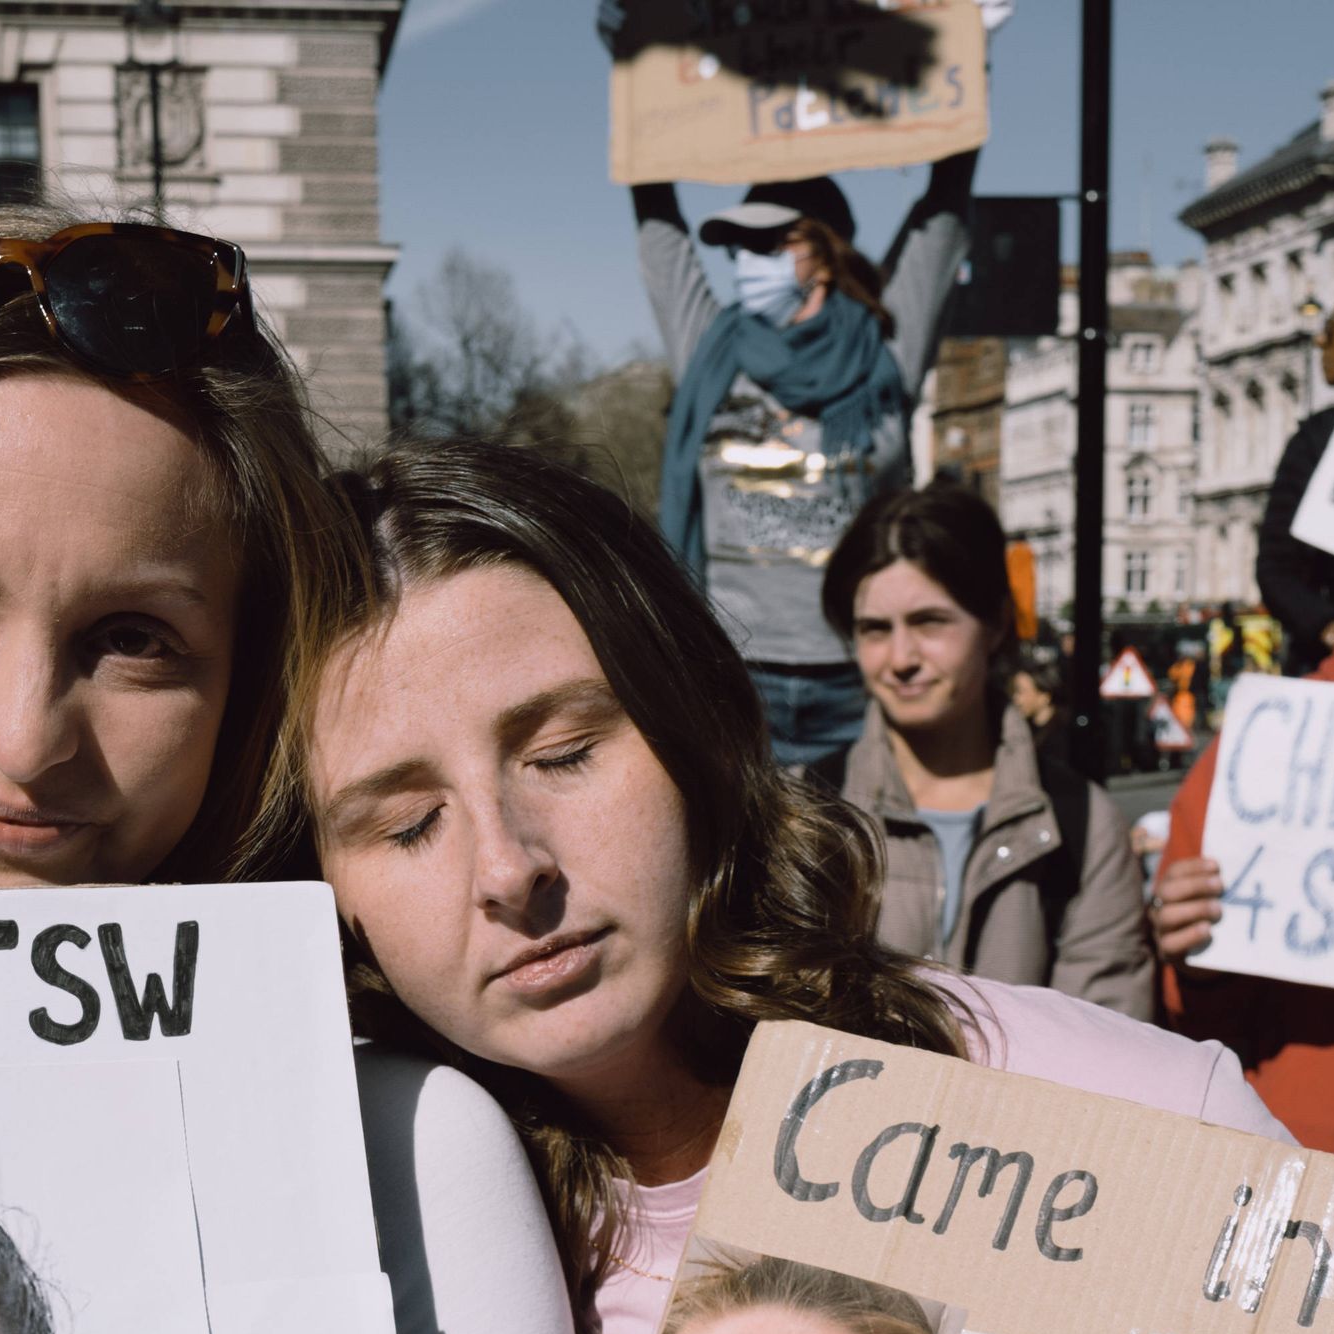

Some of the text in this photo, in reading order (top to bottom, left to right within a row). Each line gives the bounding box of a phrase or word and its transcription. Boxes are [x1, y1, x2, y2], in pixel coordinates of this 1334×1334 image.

[1221, 844, 1273, 942] 4
[772, 1058, 1099, 1263] Came
[1201, 1184, 1333, 1329] in
